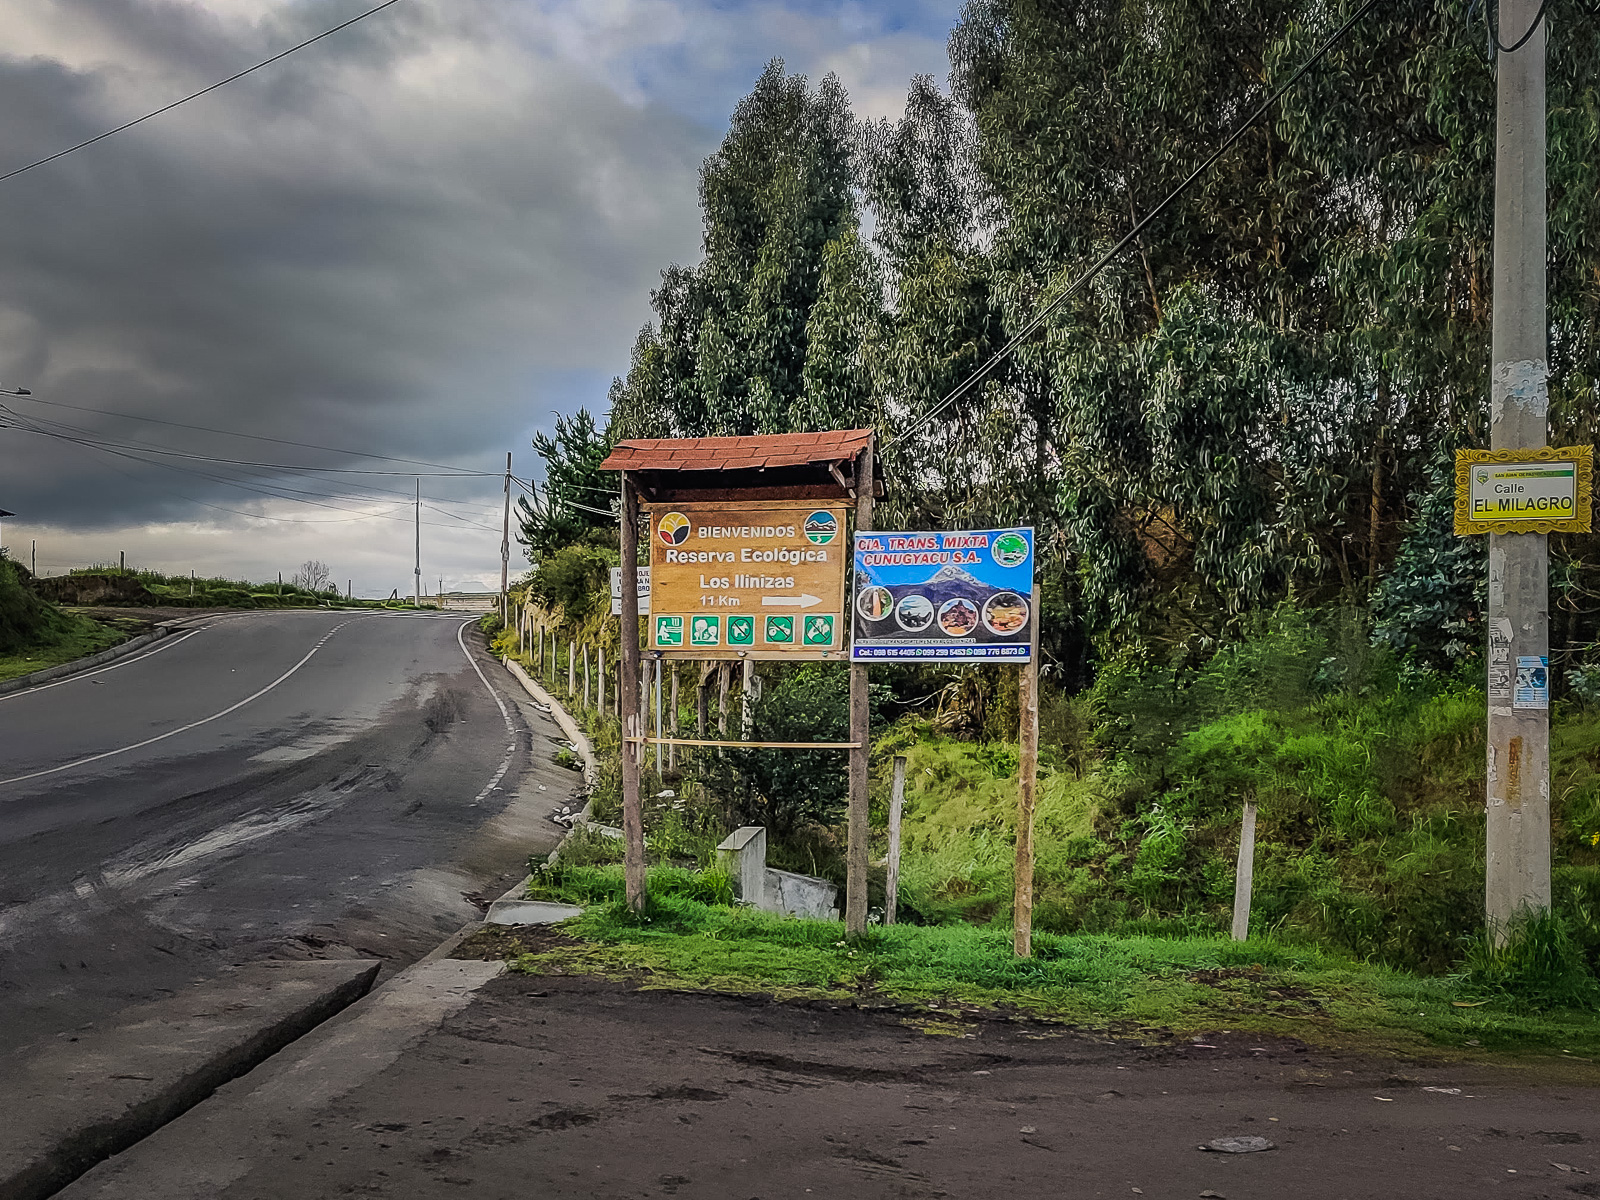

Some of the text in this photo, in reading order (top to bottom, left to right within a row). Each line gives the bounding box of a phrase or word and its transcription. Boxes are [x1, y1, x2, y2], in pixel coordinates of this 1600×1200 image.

[1495, 484, 1524, 494] Calle
[1474, 496, 1572, 512] EL MILAGRO
[698, 526, 796, 539] BIENVENIDOS
[858, 534, 989, 551] CIA. TRANS. MIXTA
[666, 548, 827, 565] Reserva Ecológica
[863, 551, 981, 566] CUNUGYACU S.A.
[699, 574, 795, 589] Los Ilinizas
[700, 595, 740, 607] 11 Km
